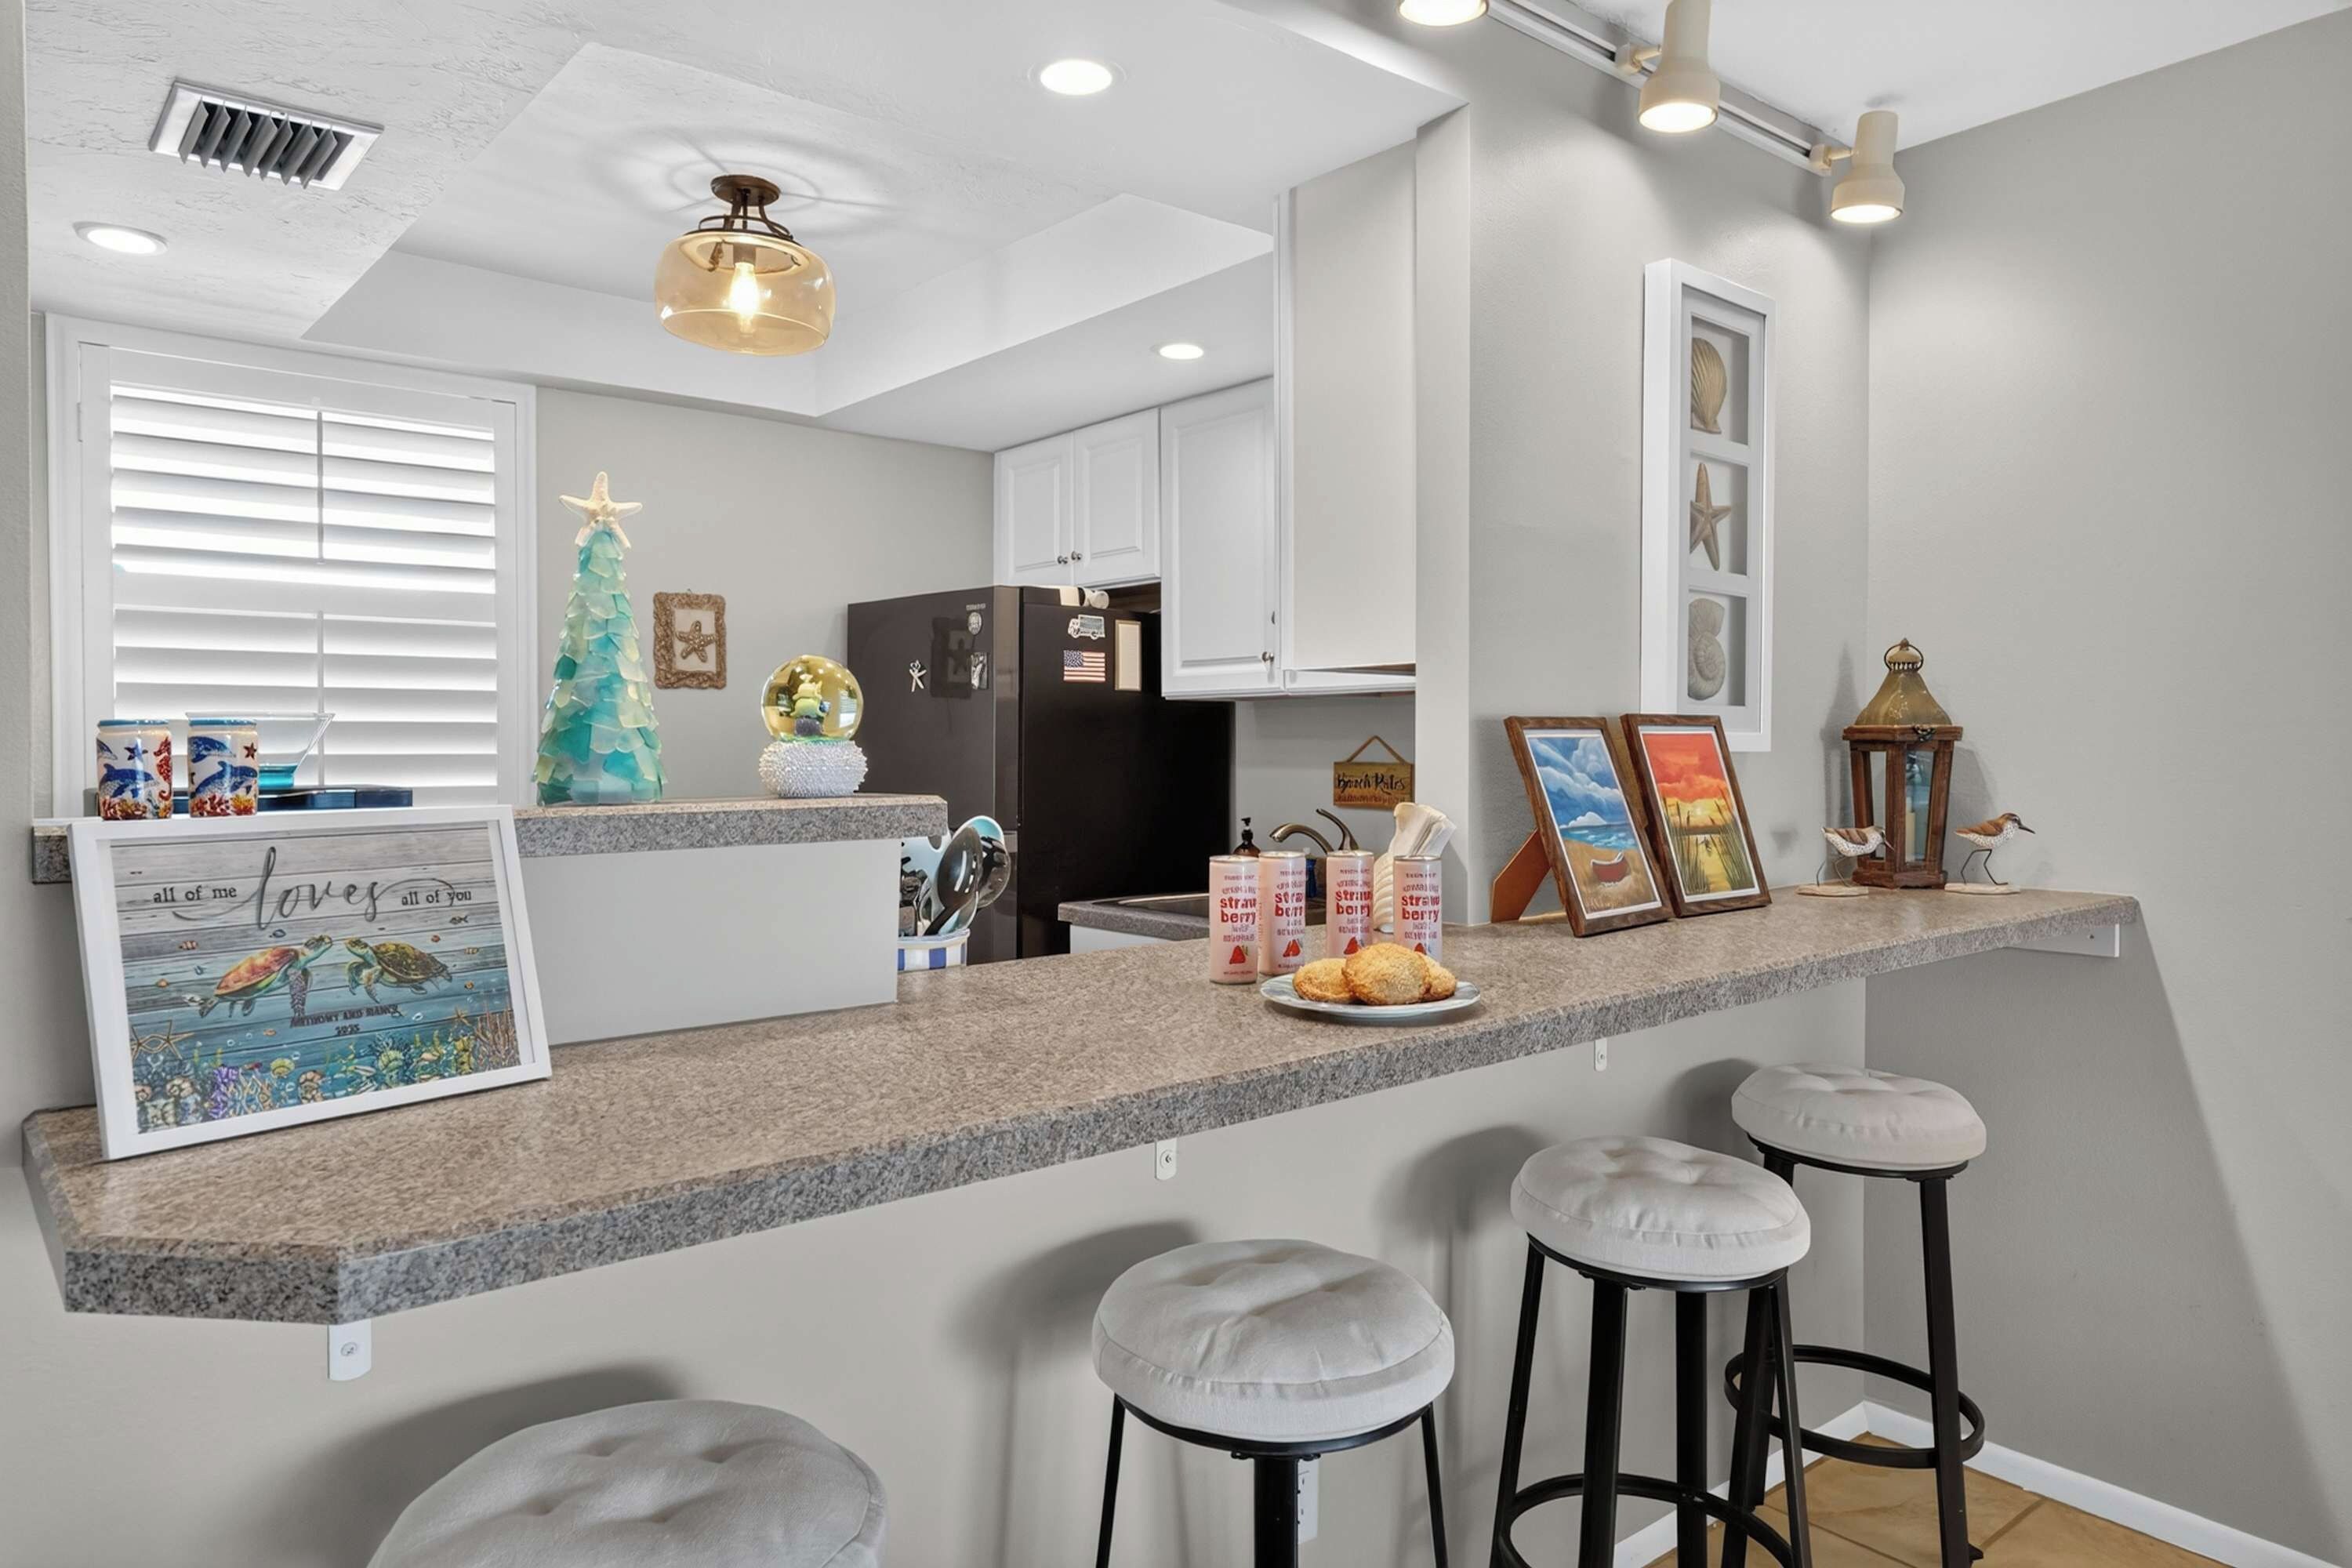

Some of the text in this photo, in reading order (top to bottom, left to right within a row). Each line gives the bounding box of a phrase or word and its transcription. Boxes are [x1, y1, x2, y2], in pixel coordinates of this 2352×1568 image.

[153, 846, 472, 931] all of me loves all of you
[1220, 896, 1257, 909] straw
[1275, 891, 1304, 904] stra
[1401, 895, 1440, 907] straw
[1275, 904, 1303, 917] berr
[1402, 908, 1440, 923] berry
[1221, 910, 1257, 925] berry
